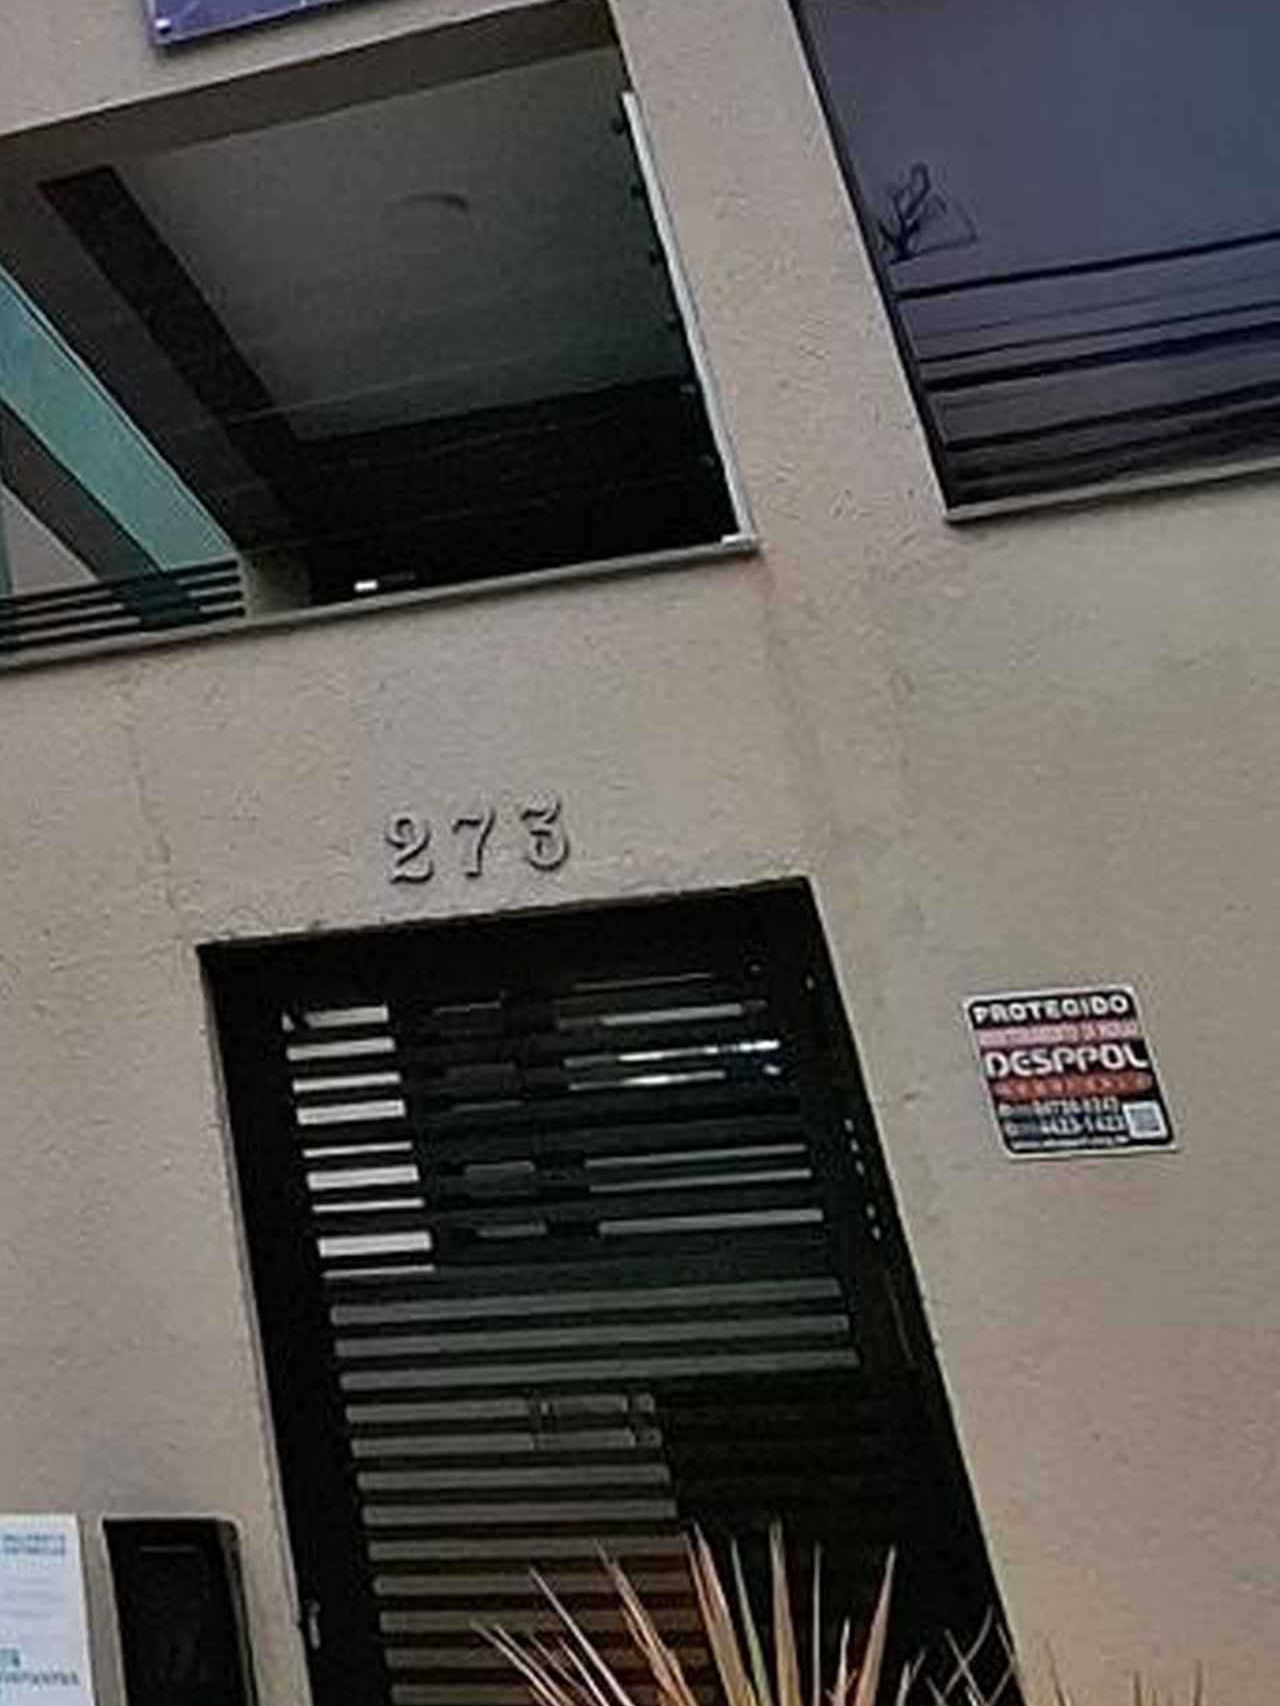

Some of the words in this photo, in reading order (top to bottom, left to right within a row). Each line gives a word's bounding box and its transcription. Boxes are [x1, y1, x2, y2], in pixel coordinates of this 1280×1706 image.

[386, 792, 570, 884] 273
[972, 994, 1130, 1024] PROTEGIDO
[985, 1043, 1149, 1078] DESPPOL
